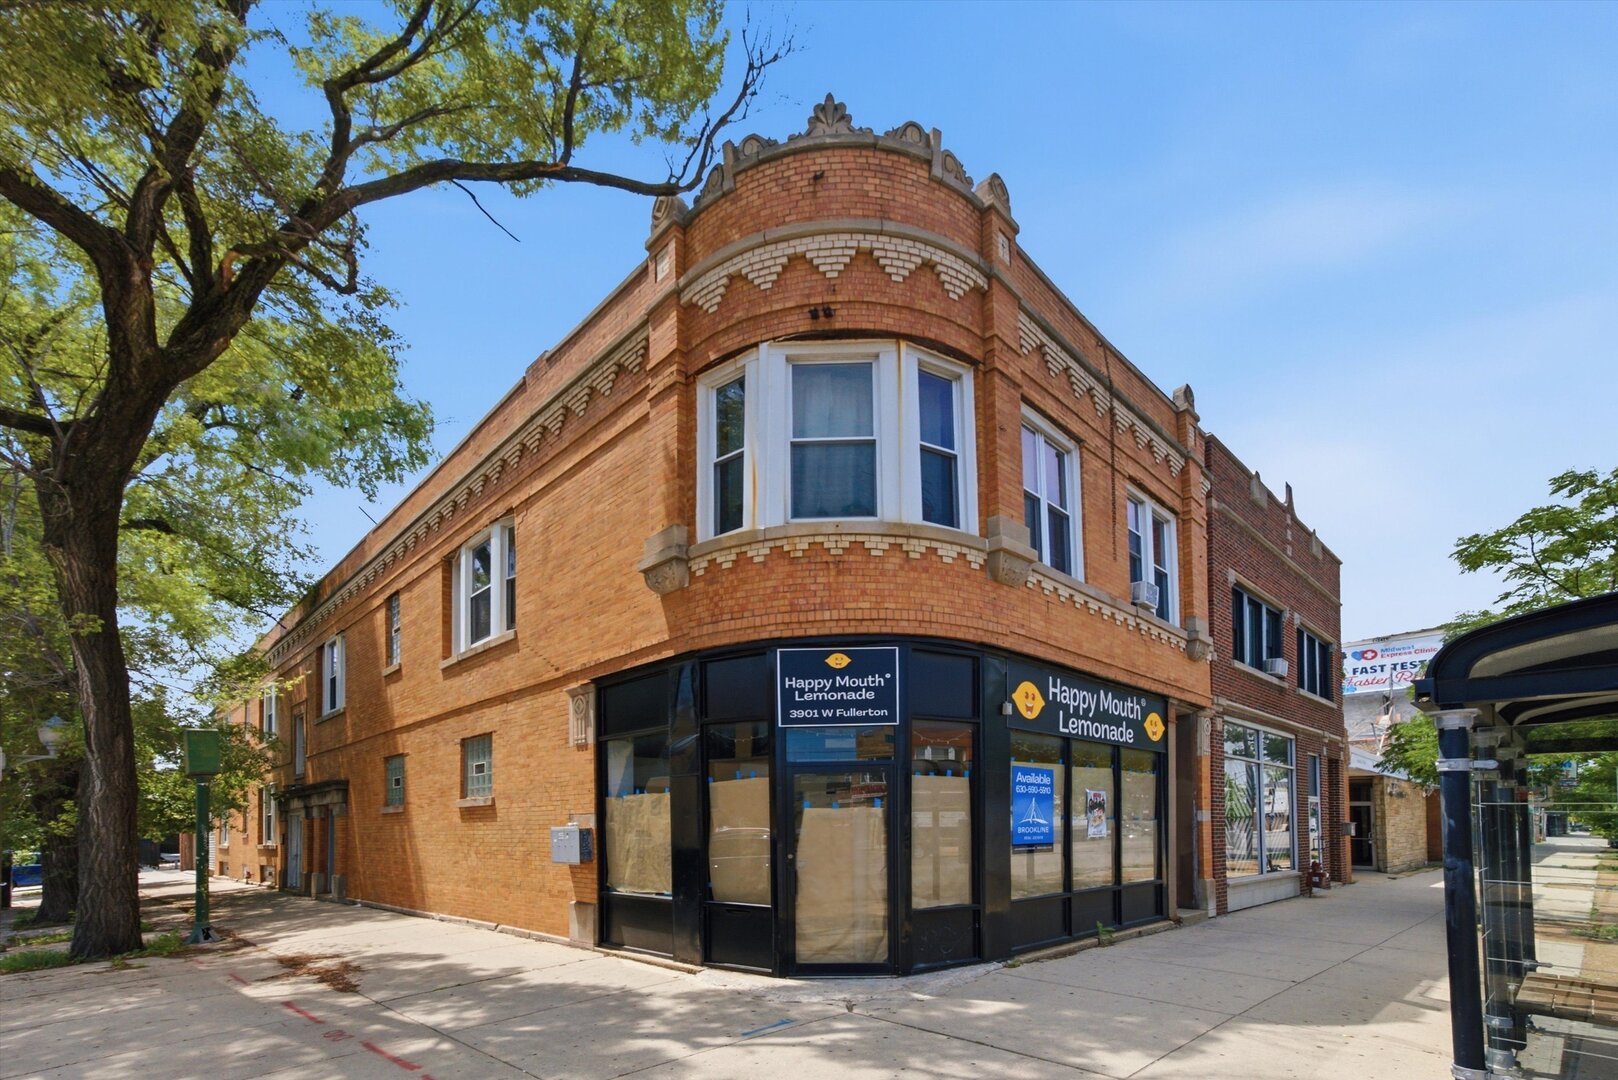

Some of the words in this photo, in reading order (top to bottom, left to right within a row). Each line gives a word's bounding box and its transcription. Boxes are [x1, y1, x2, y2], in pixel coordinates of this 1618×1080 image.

[1381, 645, 1415, 653] Midwest
[1381, 650, 1412, 658] Express
[1352, 664, 1387, 676] FAST
[785, 676, 833, 692] Happy
[1346, 675, 1390, 688] Faster
[794, 688, 876, 701] Lemonade
[1049, 676, 1097, 718] Happy
[789, 709, 819, 718] 3901
[822, 709, 833, 717] W
[836, 708, 888, 717] Fullerton
[1058, 709, 1135, 744] Lemonade
[1016, 772, 1051, 785] Available
